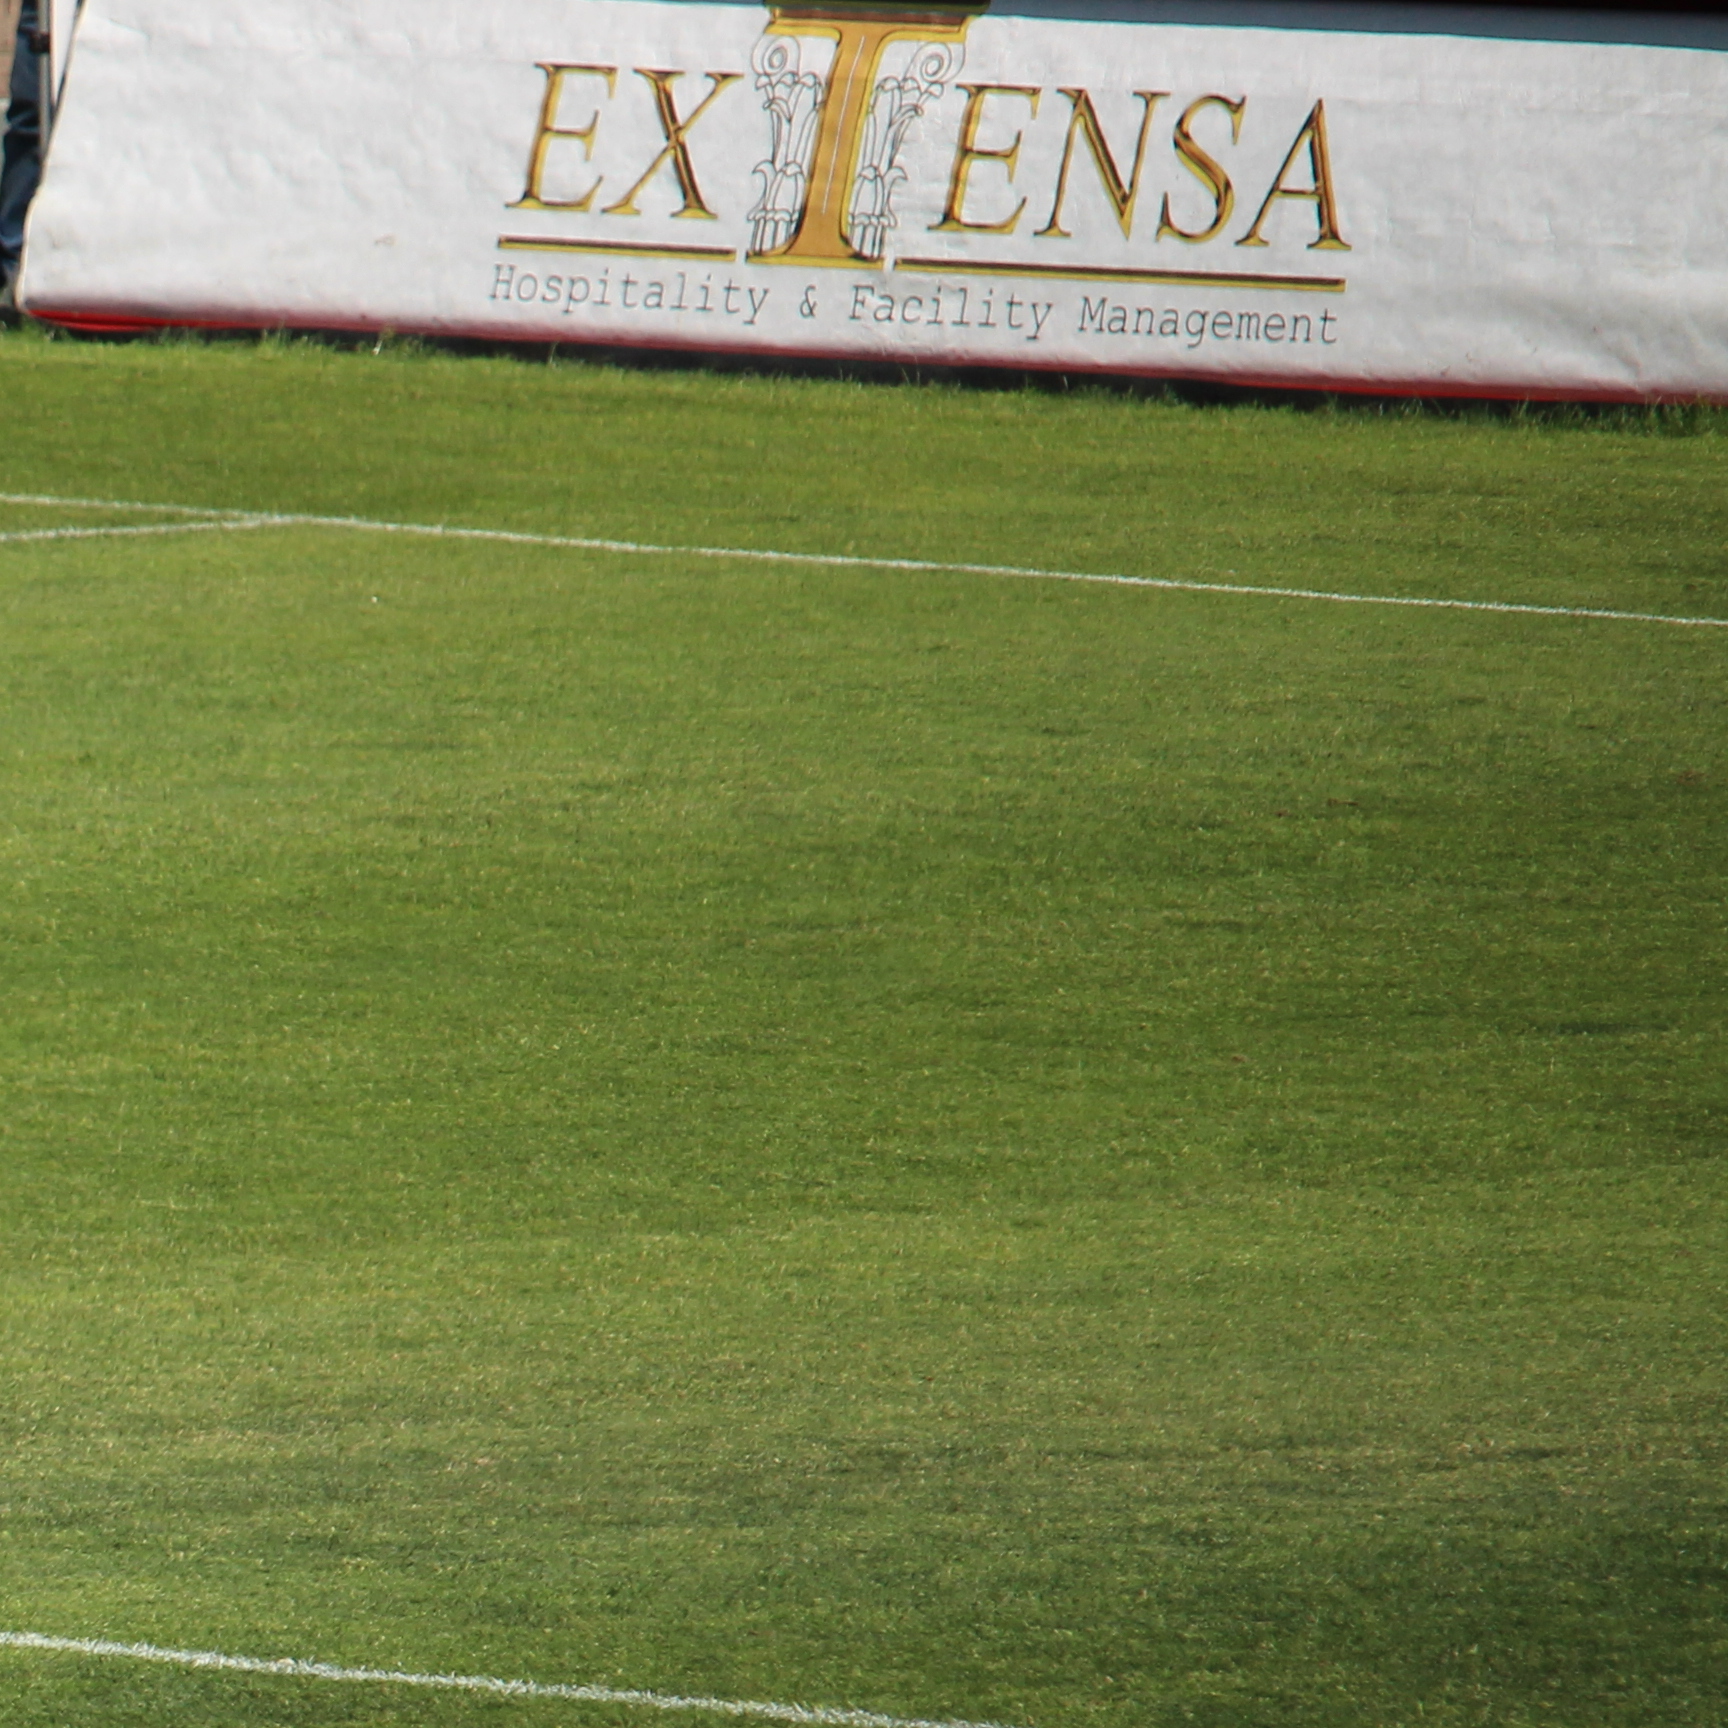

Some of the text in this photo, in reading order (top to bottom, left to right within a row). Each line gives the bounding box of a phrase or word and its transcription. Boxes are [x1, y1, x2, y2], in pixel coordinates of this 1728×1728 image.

[504, 7, 1352, 268] EXTENSA
[489, 263, 1340, 348] Hospitality & Facility Management
